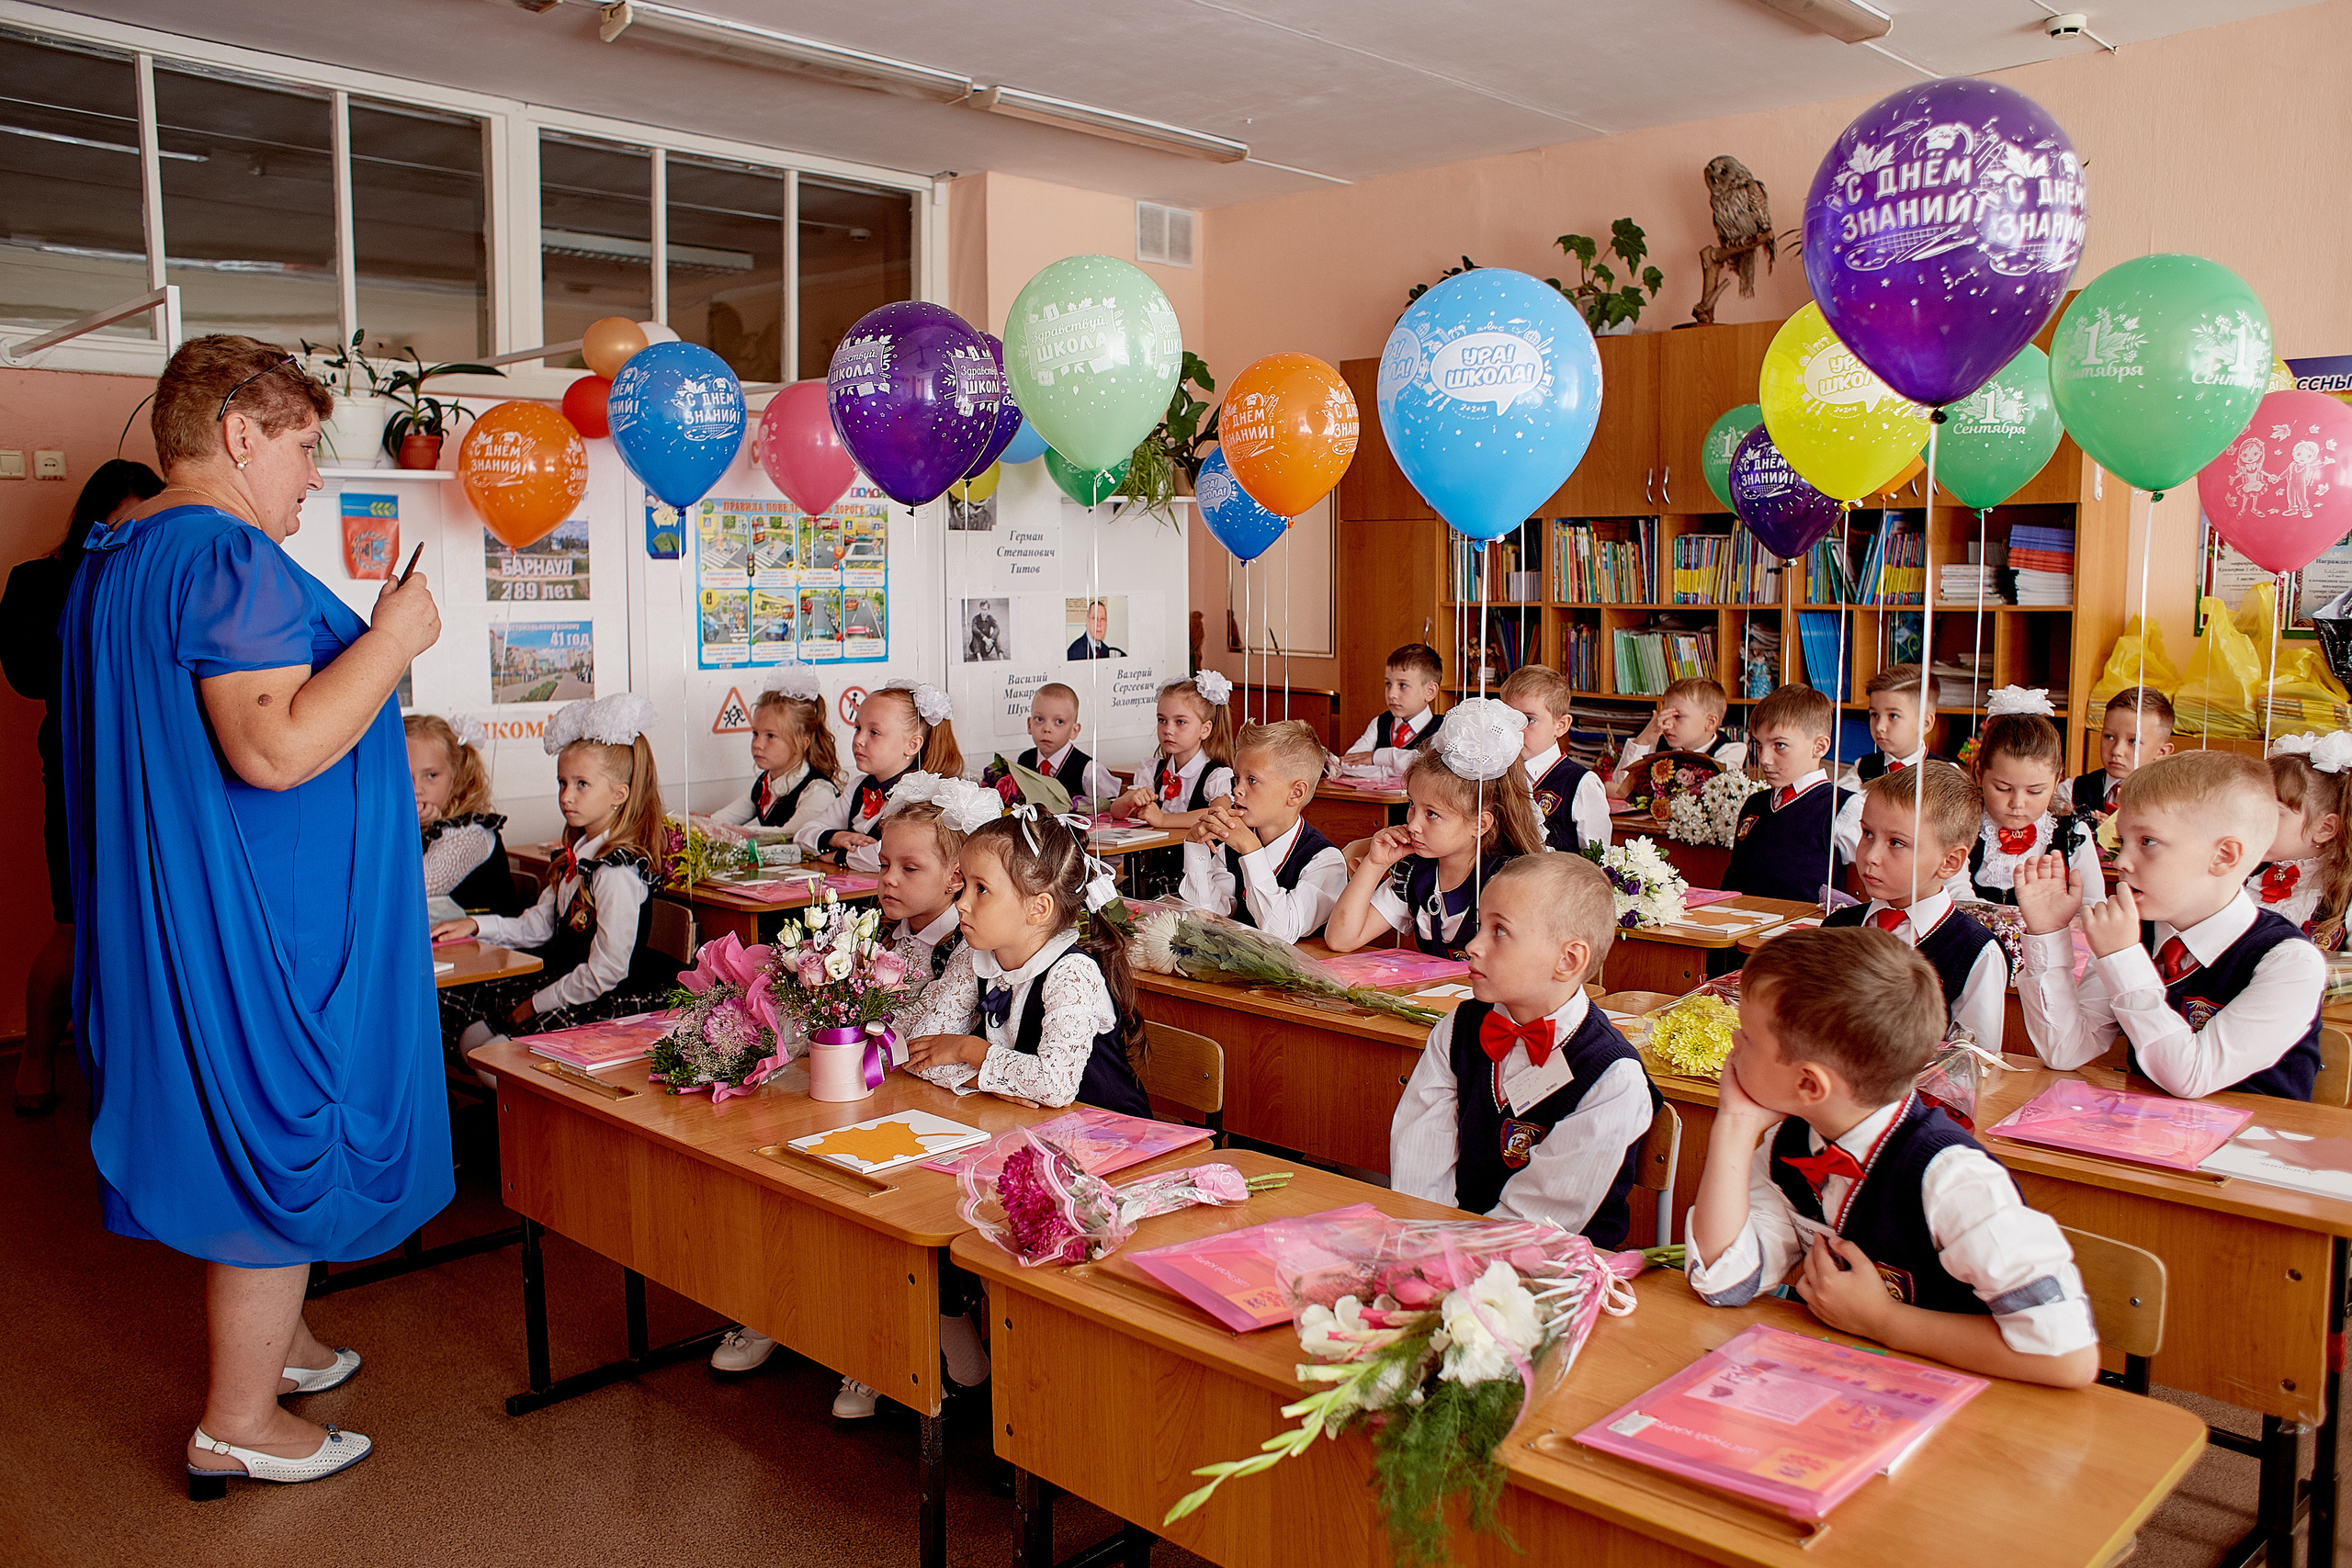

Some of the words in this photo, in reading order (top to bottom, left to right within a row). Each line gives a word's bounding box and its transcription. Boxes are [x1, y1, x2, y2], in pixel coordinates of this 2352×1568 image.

[1844, 174, 1863, 206] С
[1873, 150, 1973, 202] ДНЁМ
[2005, 175, 2027, 205] С
[2037, 174, 2085, 211] ДНЁМ
[1035, 332, 1108, 364] ШКОЛА
[1385, 339, 1407, 360] РА!
[2080, 321, 2104, 366] 1
[2227, 324, 2250, 372] 1
[1462, 344, 1516, 366] УРА!
[831, 362, 875, 385] ШКОЛА
[1445, 363, 1535, 389] ШКОЛА!
[1818, 368, 1877, 396] ШКОЛ
[686, 393, 695, 407] С
[702, 389, 735, 406] ДНЁМ
[1979, 389, 2001, 424] 1
[684, 408, 741, 425] ЗНАНИЙ!
[1232, 406, 1265, 428] ДНЁМ
[1335, 403, 1342, 418] С
[1224, 423, 1275, 448] ЗНАНИЙ!
[1953, 421, 2027, 439] Сентября
[474, 445, 481, 457] С
[484, 443, 521, 457] ДНЁМ
[470, 459, 527, 476] ЗНАНИЙ!
[1743, 459, 1750, 472] С
[1753, 454, 1788, 471] ДНЁМ
[1740, 470, 1795, 487] ЗНАНИЙ!
[722, 501, 763, 513] ПРАВИЛА
[834, 504, 865, 515] ДОРОГЕ
[1009, 529, 1044, 544] Герман
[996, 546, 1056, 558] Степанович
[501, 558, 574, 577] БАРНАУЛ
[1010, 563, 1041, 574] Титов
[500, 581, 538, 601] 289
[541, 584, 575, 600] лет
[550, 631, 564, 647] 41
[566, 632, 590, 648] год
[1008, 672, 1048, 685] Василий
[1116, 668, 1153, 680] Валерий
[1003, 688, 1037, 700] Макар
[1113, 682, 1155, 694] Сергеевич
[1007, 704, 1031, 716] Шук
